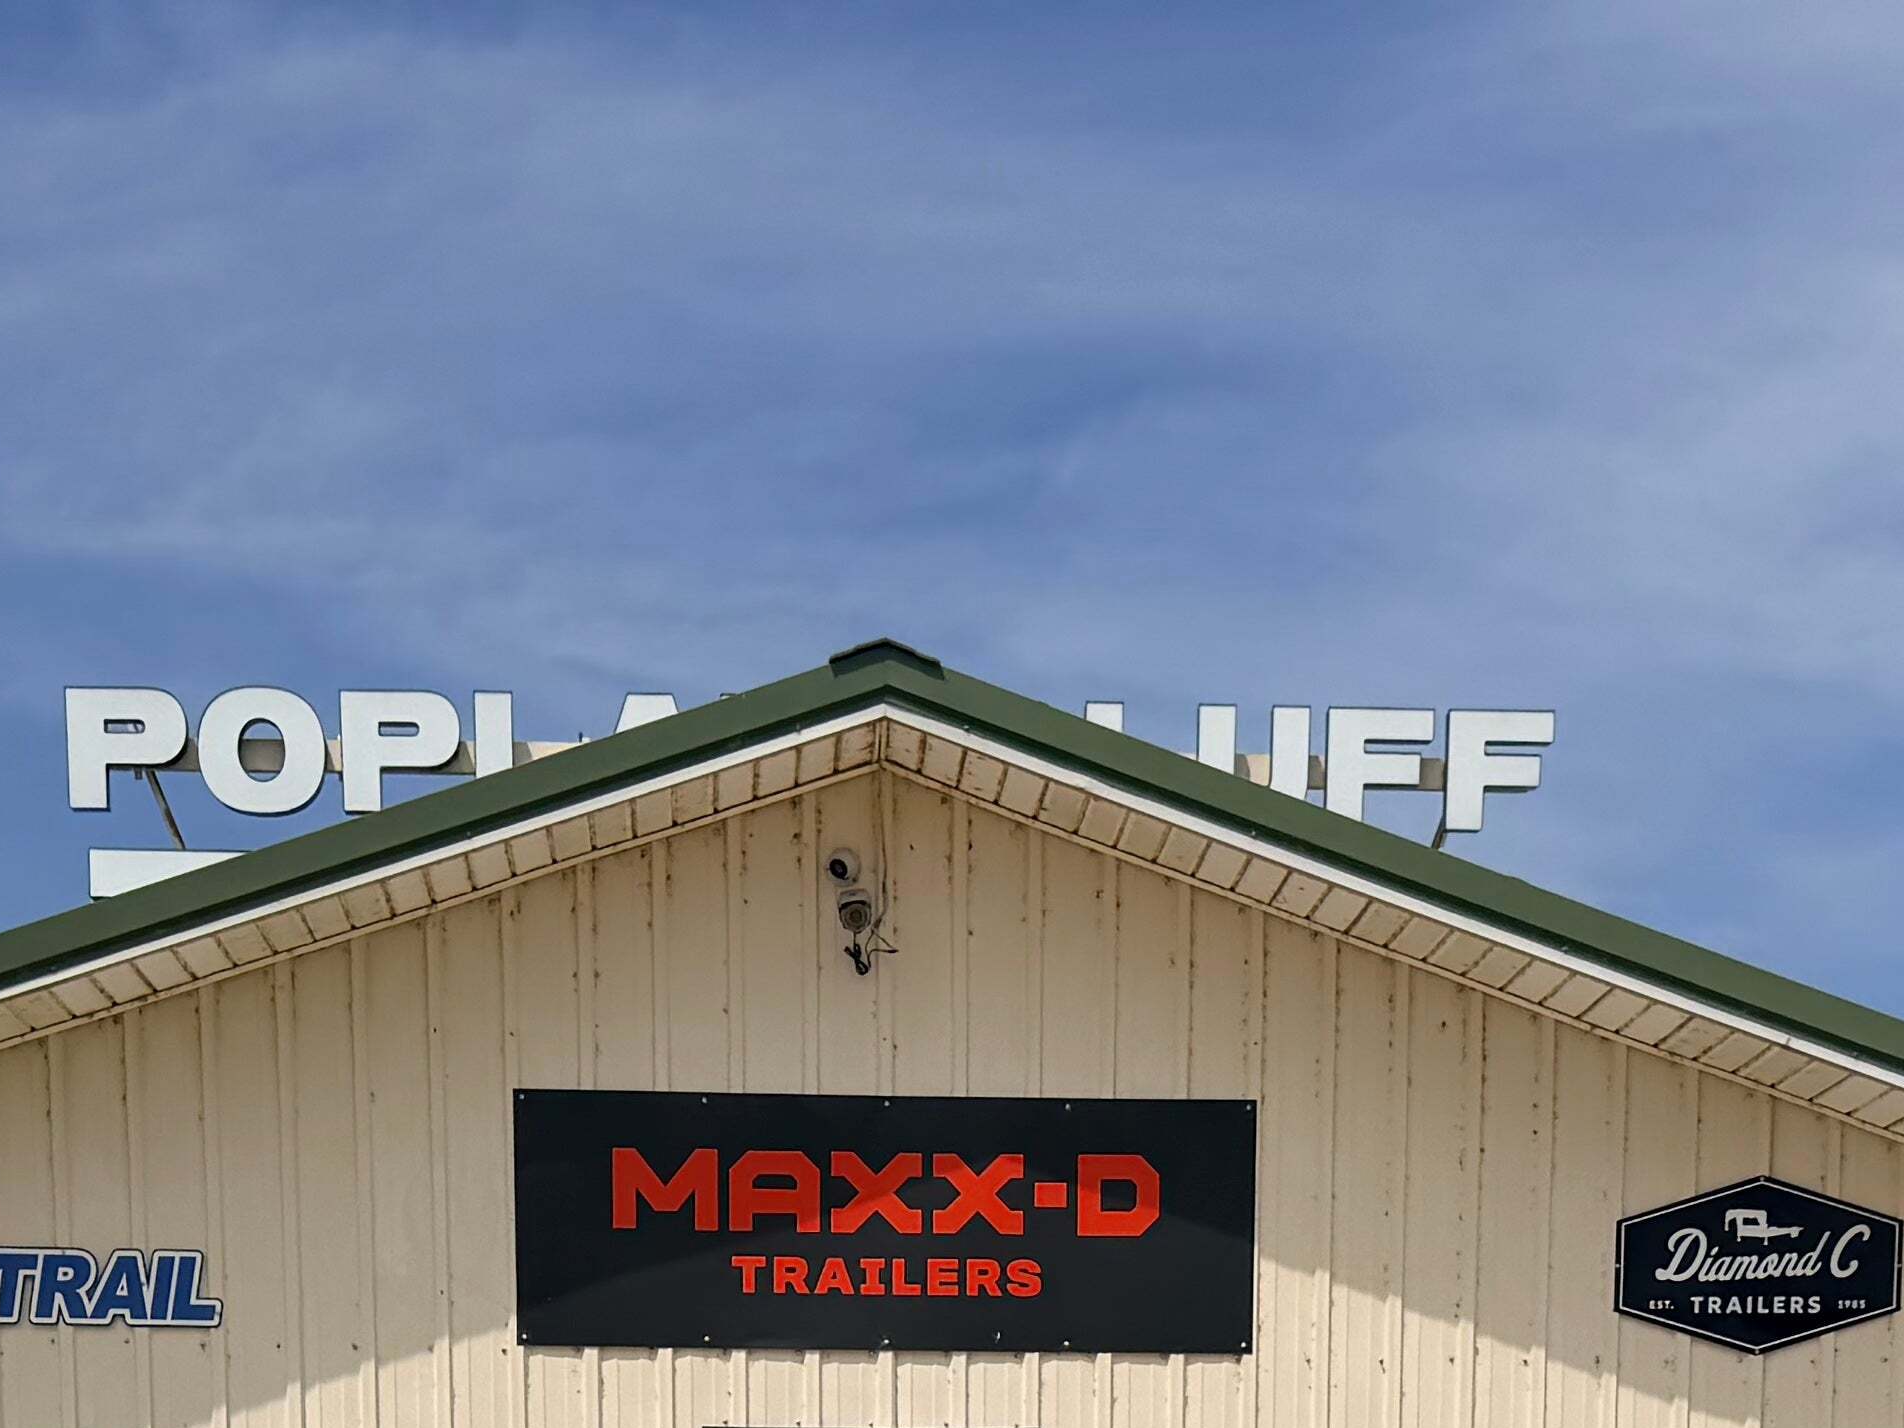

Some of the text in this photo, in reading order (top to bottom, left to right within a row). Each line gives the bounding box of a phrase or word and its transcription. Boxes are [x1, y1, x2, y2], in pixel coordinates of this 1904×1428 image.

[611, 1146, 1161, 1238] MAXX-D
[730, 1255, 1044, 1298] TRAILERS
[1654, 1223, 1872, 1283] Diamond C
[1690, 1295, 1821, 1315] TRAILERS
